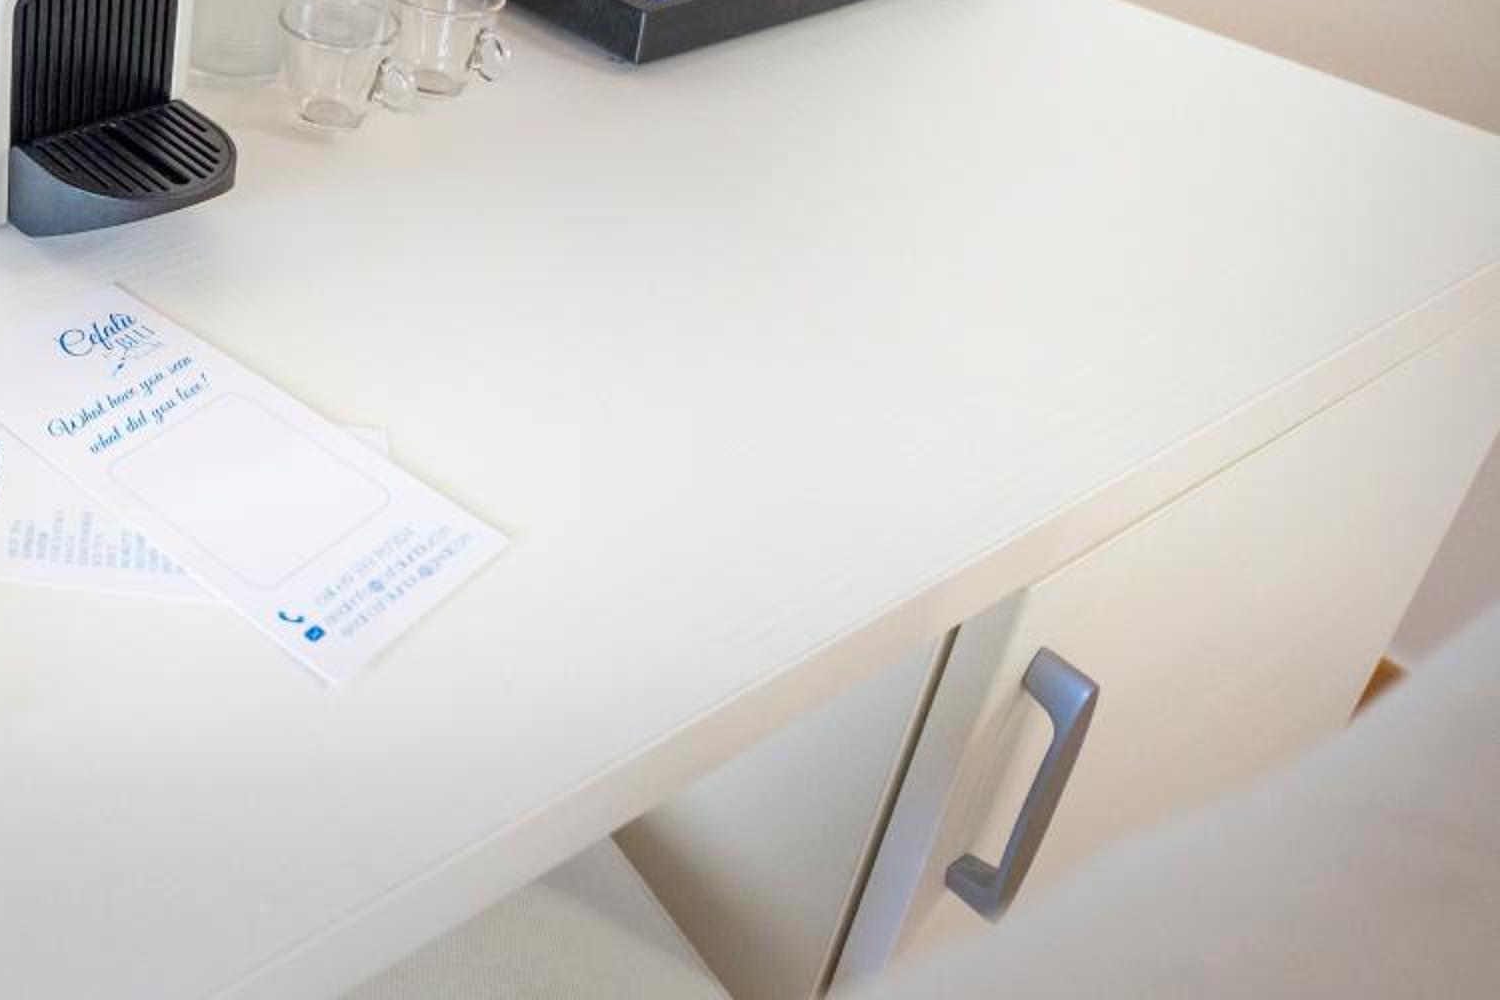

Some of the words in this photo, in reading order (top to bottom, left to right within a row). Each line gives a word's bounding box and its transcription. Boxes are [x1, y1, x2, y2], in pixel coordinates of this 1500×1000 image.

[59, 313, 135, 356] Cefalù
[115, 325, 155, 351] BLU
[48, 402, 105, 435] What
[105, 388, 135, 410] have
[138, 371, 165, 397] you
[89, 426, 122, 454] what
[124, 409, 148, 433] did
[150, 399, 177, 424] you
